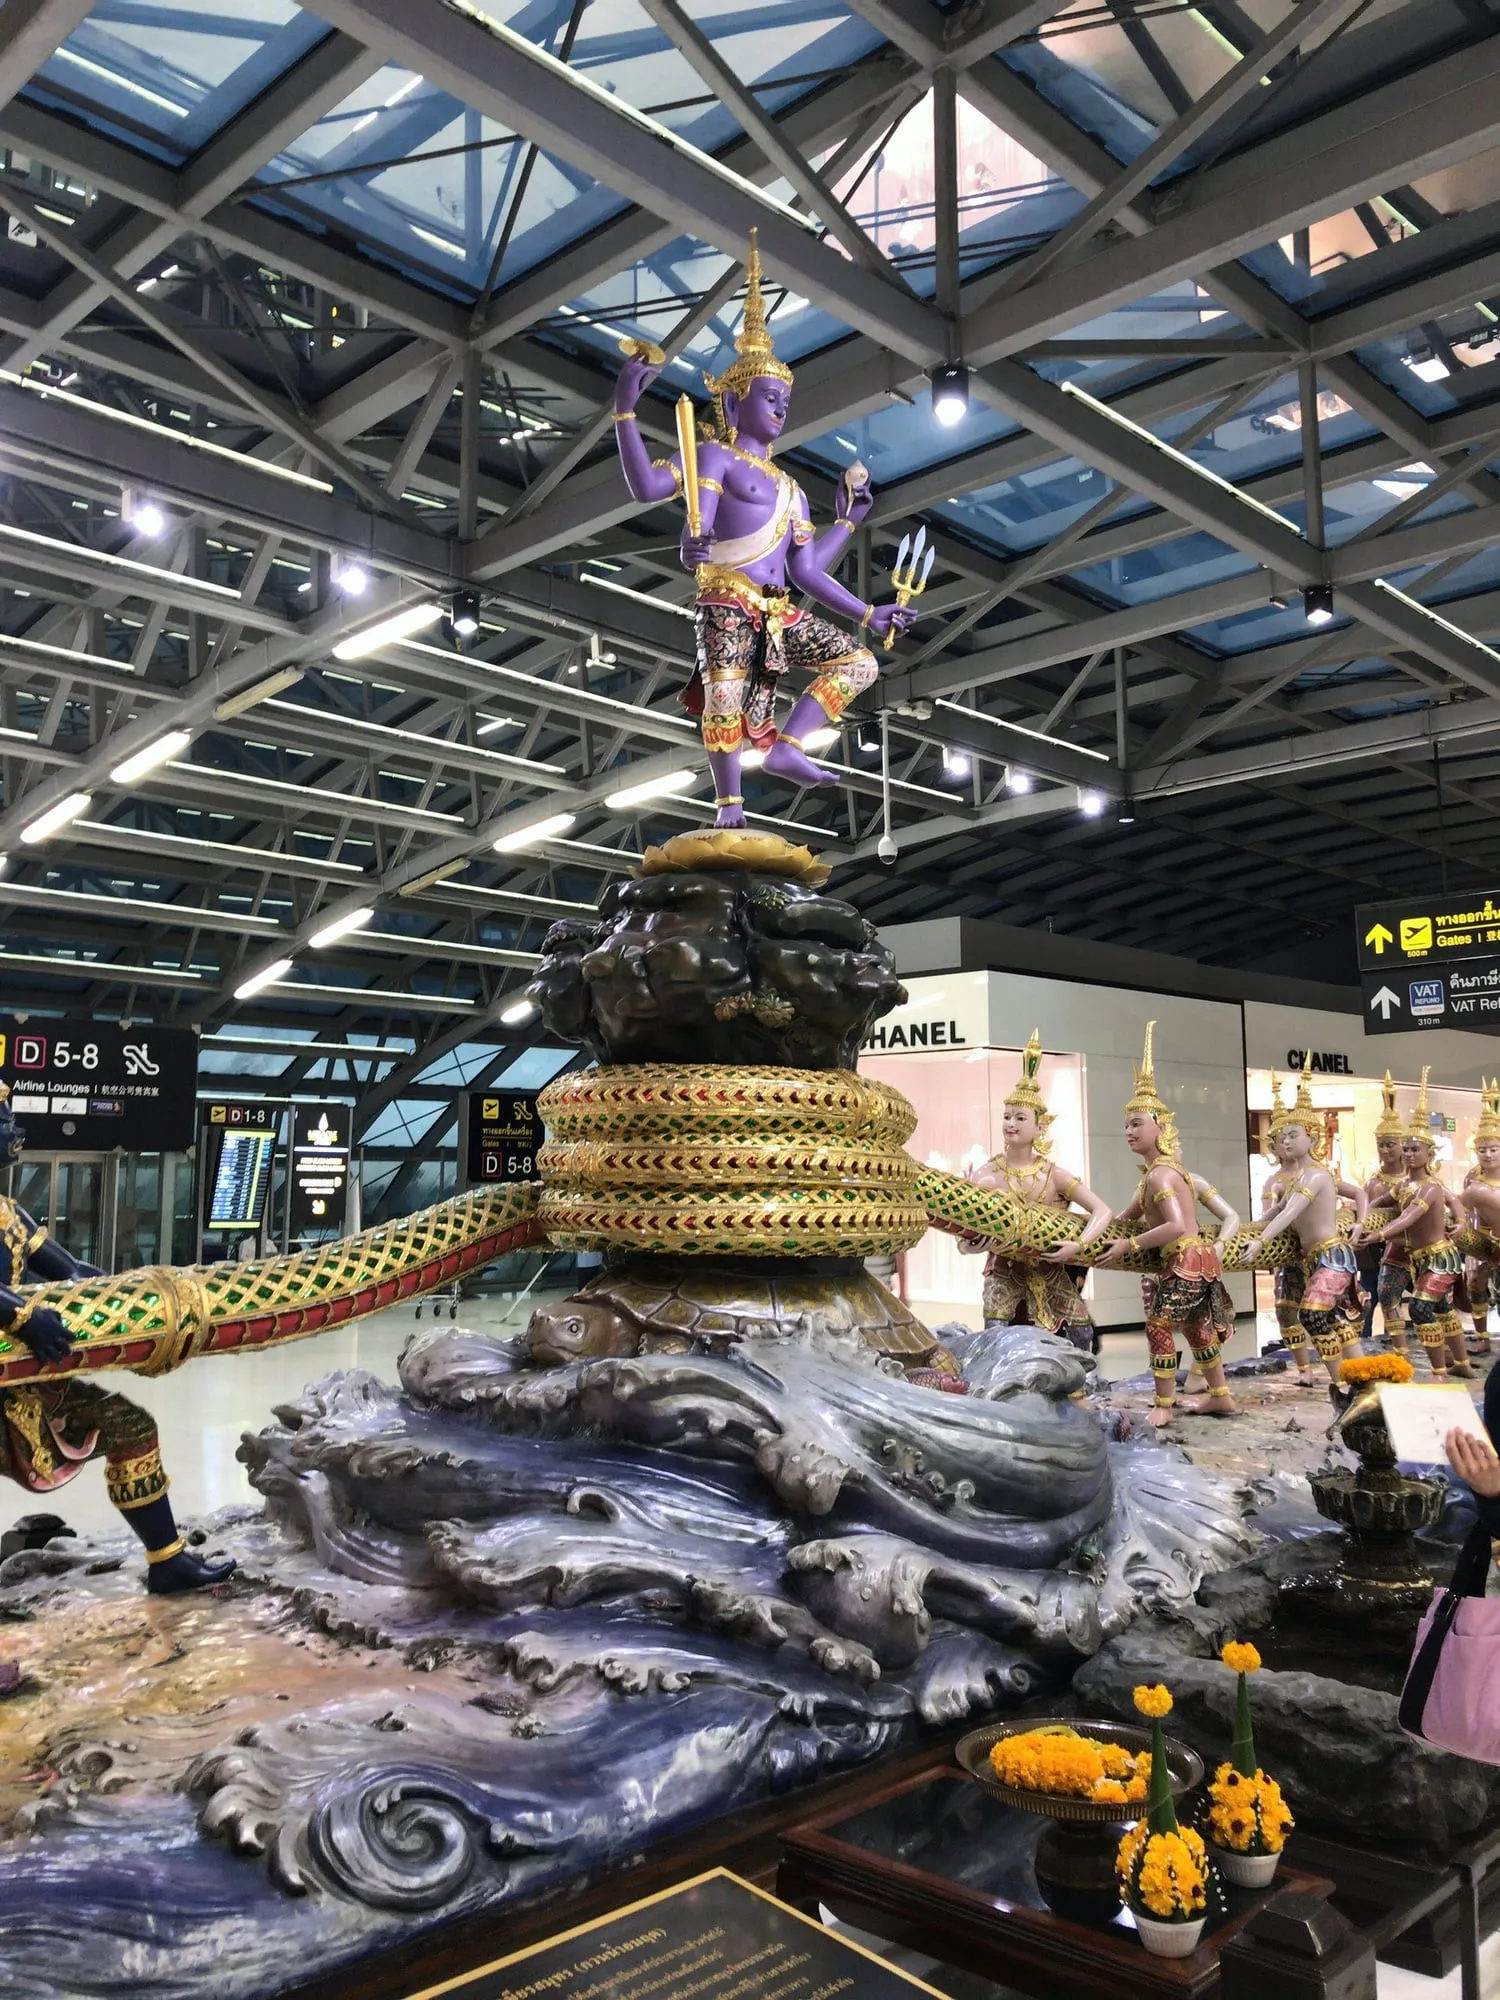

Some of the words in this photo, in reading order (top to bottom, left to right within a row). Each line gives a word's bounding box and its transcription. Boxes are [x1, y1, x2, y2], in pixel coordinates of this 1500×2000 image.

[1436, 935, 1472, 947] Gates
[1450, 968, 1500, 989] คืนภาษี
[1414, 984, 1439, 997] VAT
[1451, 1000, 1476, 1013] VAT
[860, 1021, 965, 1050] HANEL
[21, 1041, 40, 1063] D
[53, 1042, 99, 1069] 5-8
[13, 1080, 45, 1092] Airline
[48, 1081, 90, 1096] Lounges
[231, 1110, 241, 1121] D
[244, 1110, 265, 1123] 1-8
[486, 1155, 498, 1173] D
[508, 1156, 532, 1174] 5-8
